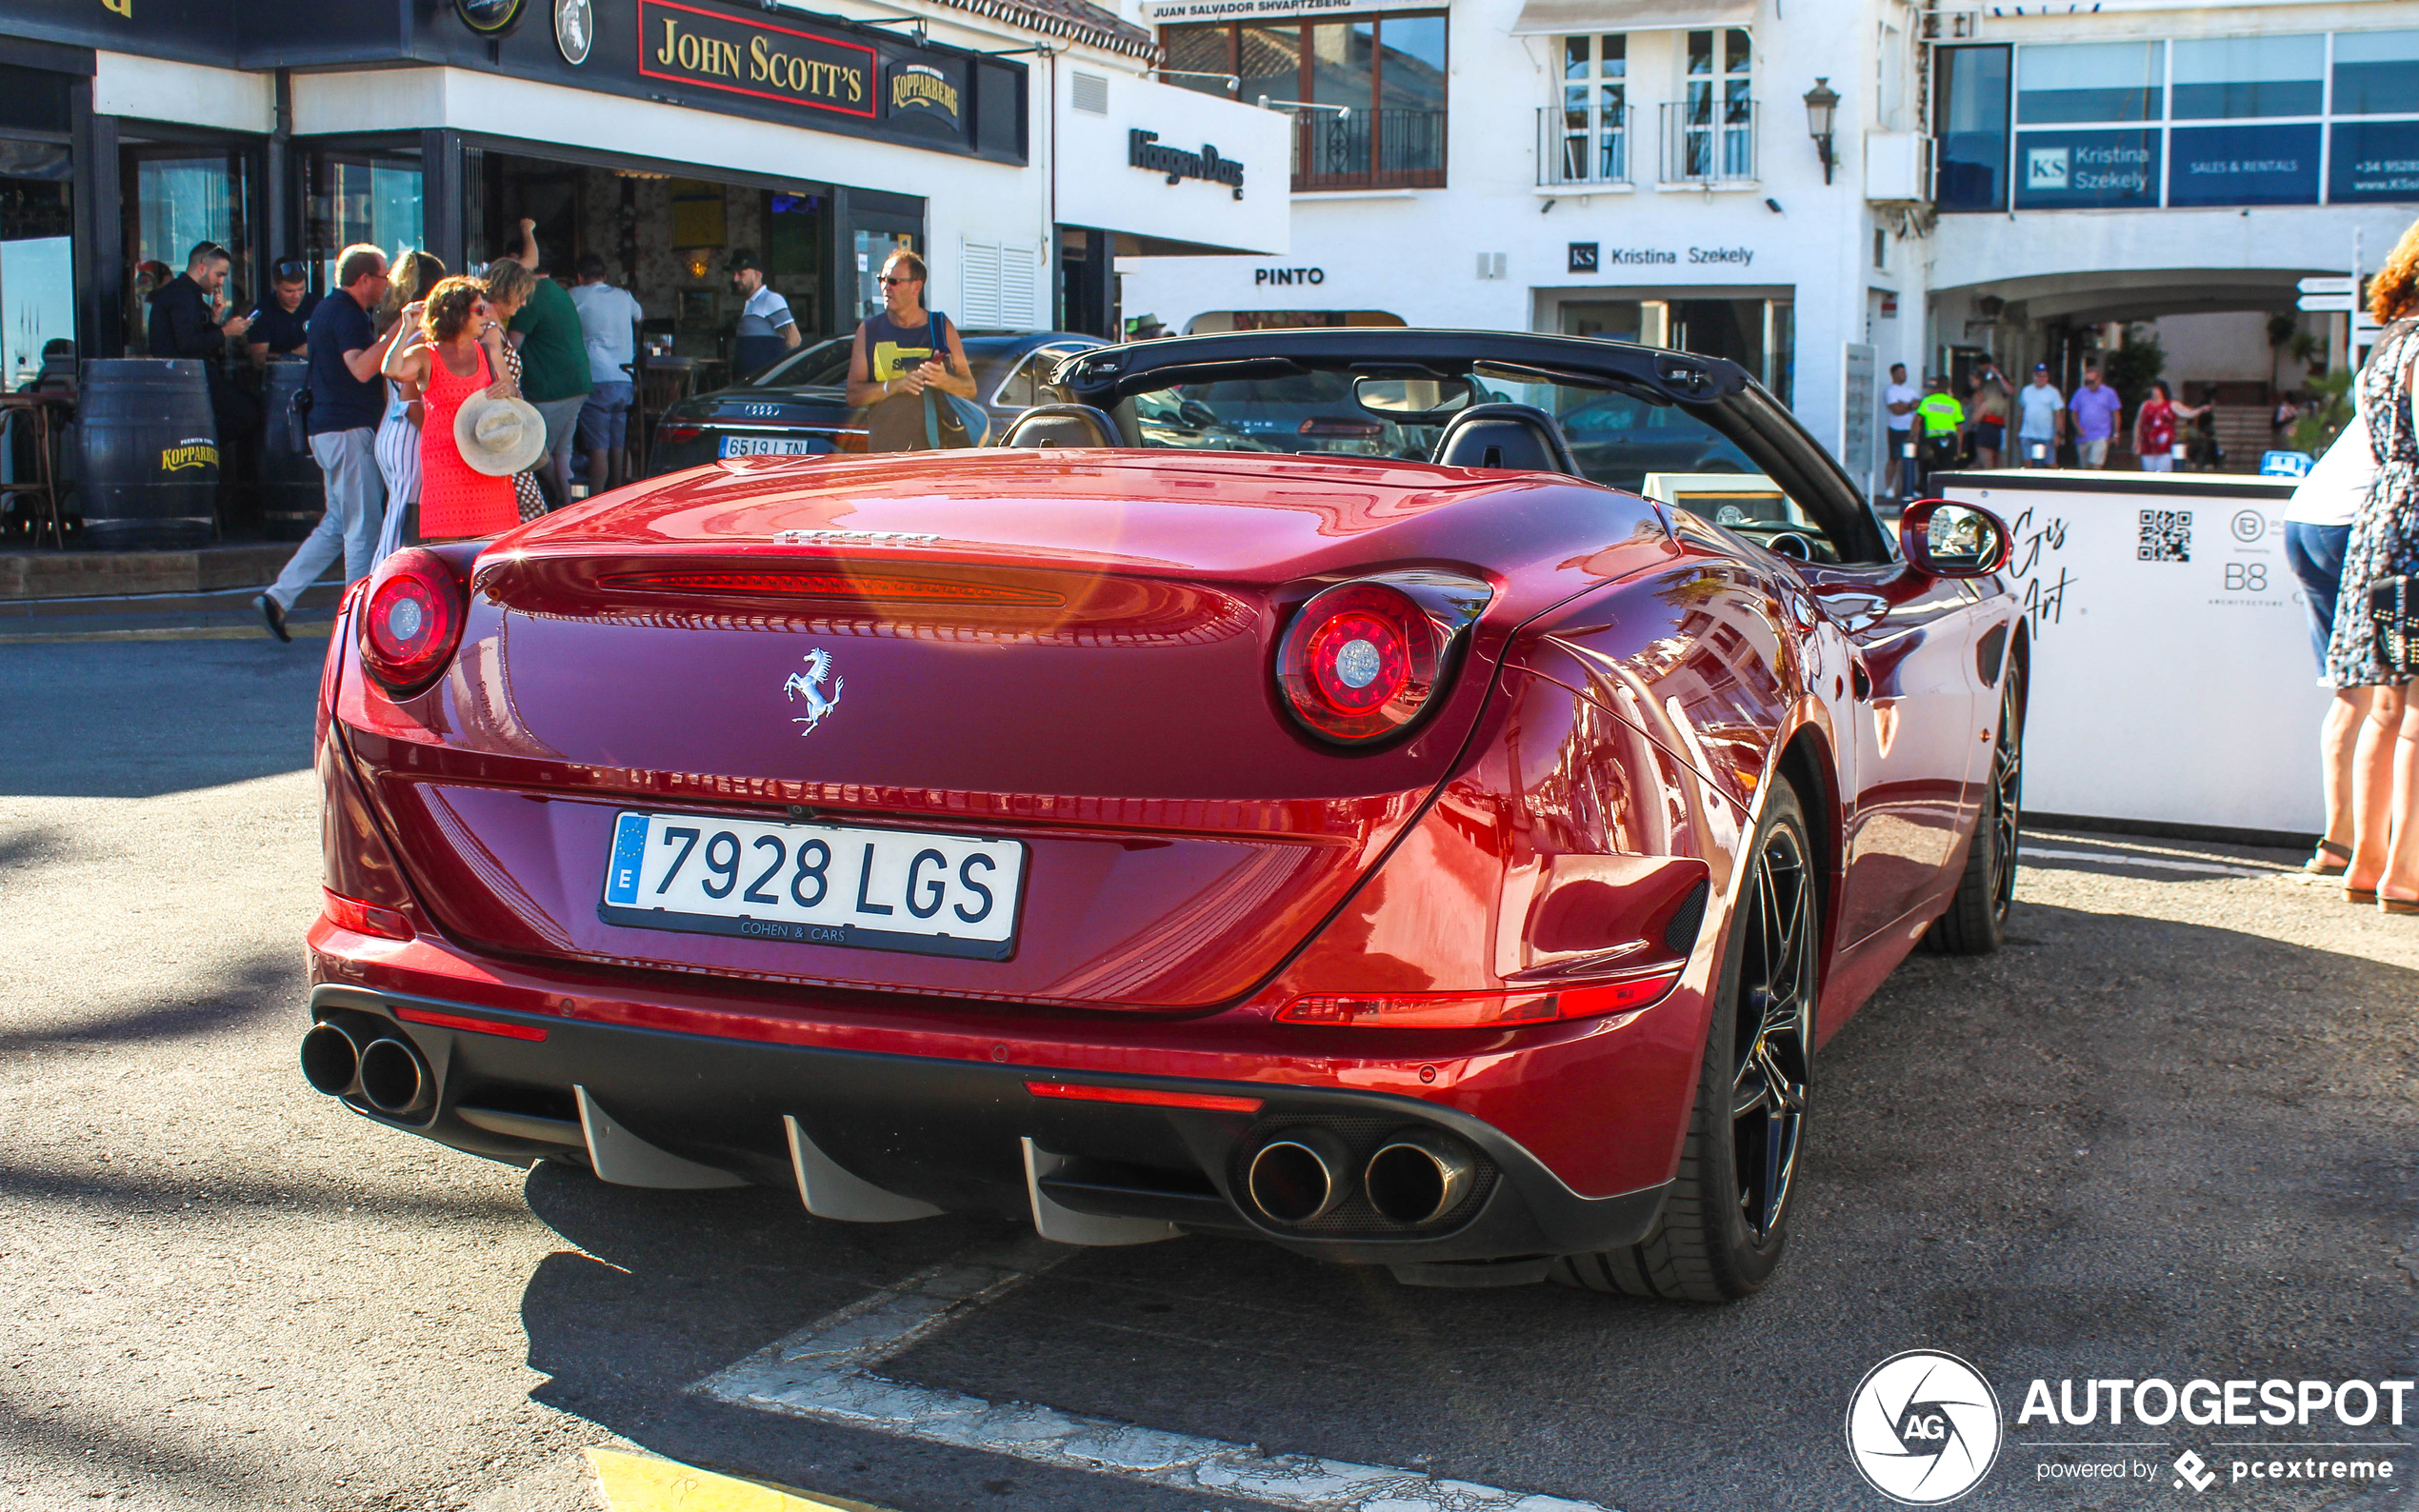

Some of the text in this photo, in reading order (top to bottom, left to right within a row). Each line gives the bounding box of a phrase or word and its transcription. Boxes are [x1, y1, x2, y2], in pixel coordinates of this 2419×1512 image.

[1153, 7, 1186, 17] JUAN
[1190, 2, 1254, 15] SALVADOR
[657, 18, 862, 103] JOHN SCOTT'S
[892, 73, 958, 117] KOPPARBERG
[2075, 147, 2149, 164] Kristina
[2032, 158, 2066, 179] KS
[2189, 159, 2298, 174] SALES & RENTALS
[2075, 172, 2149, 191] Szekely
[1572, 246, 1754, 268] KS Kristina Szekely
[1254, 268, 1325, 286] PINTO
[730, 439, 769, 455] 6519
[2225, 563, 2268, 591] B8
[2025, 567, 2078, 641] Art
[618, 826, 996, 924] E 7928 LGS
[741, 921, 846, 943] COHEN & CARS
